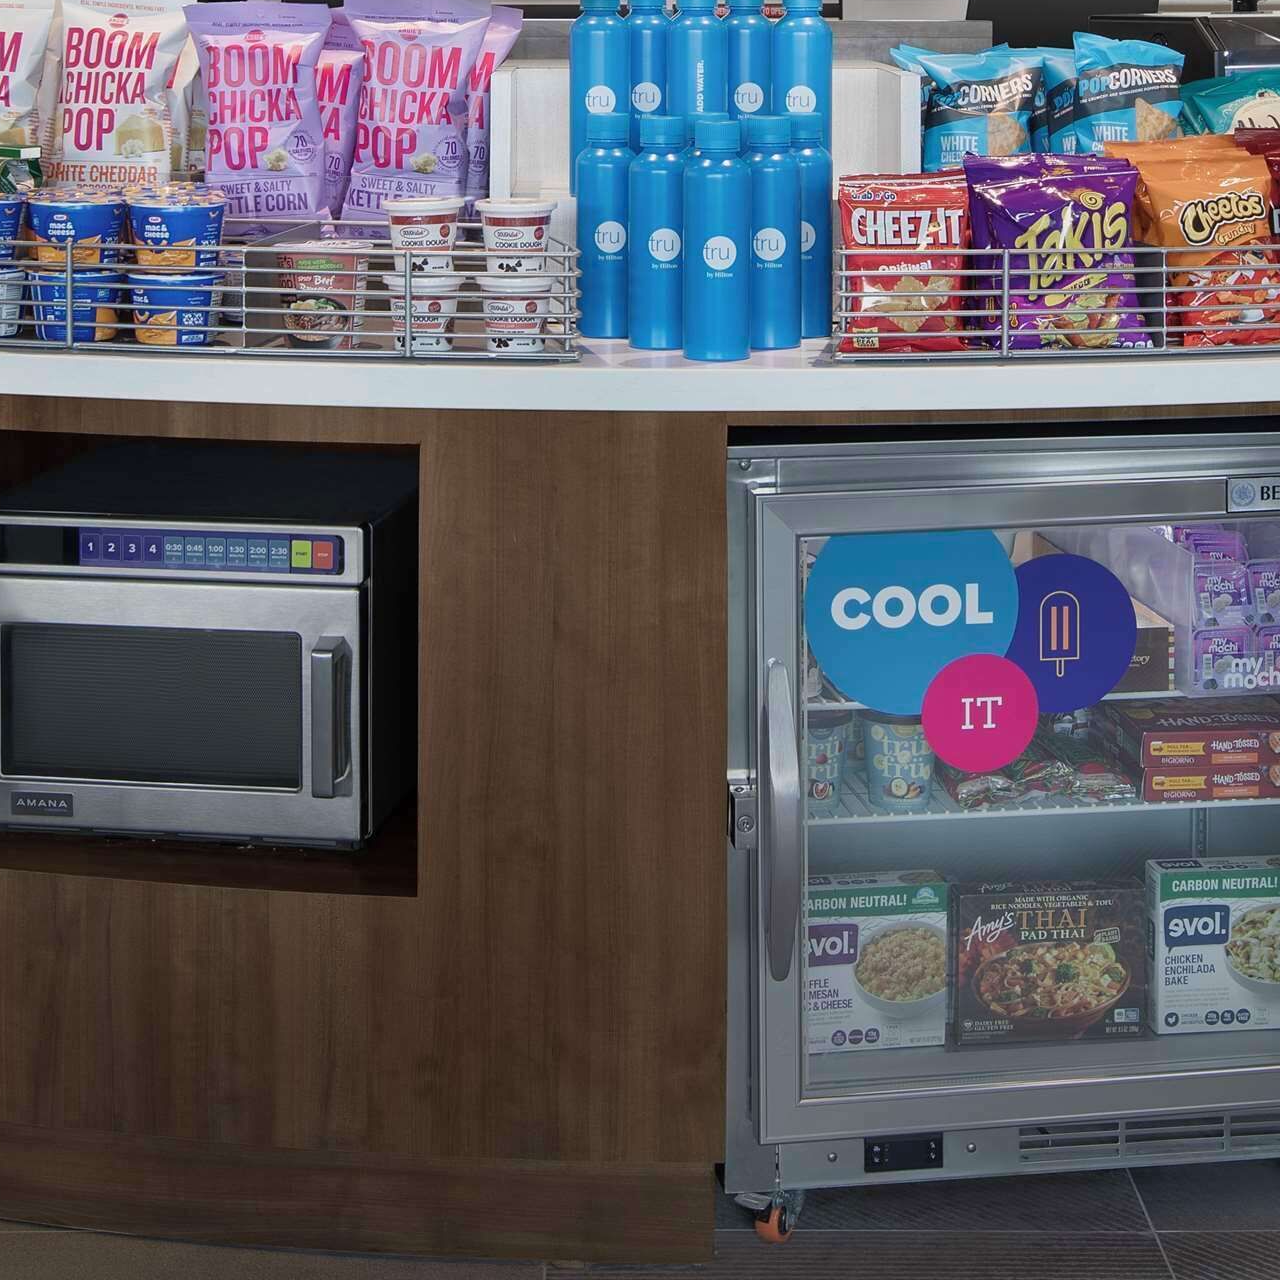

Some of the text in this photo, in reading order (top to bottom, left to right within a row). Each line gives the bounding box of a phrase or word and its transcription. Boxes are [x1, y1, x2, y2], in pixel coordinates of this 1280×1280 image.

[65, 27, 161, 70] BOOM
[207, 43, 303, 88] BOOM
[360, 39, 462, 90] BOOM
[64, 71, 146, 105] CHICKA
[1079, 68, 1177, 97] POPCORNERS
[586, 91, 609, 108] tru
[632, 89, 655, 104] tru
[734, 89, 758, 104] tru
[786, 92, 810, 108] tru
[208, 87, 302, 125] CHICKA
[359, 85, 452, 125] CHICKA
[63, 107, 115, 151] POP
[1092, 127, 1129, 142] WHITE
[208, 127, 269, 171] POP
[355, 122, 417, 169] POP
[445, 141, 457, 155] 70
[941, 135, 979, 151] WHITE
[473, 145, 485, 160] 70
[328, 155, 340, 169] 70
[89, 164, 158, 183] CHEDDAR
[221, 180, 291, 194] SWEET & SALTY
[361, 177, 436, 195] SWEET & SALTY
[265, 192, 308, 212] CORN
[883, 192, 896, 201] Go
[1181, 192, 1266, 245] Cheetos
[595, 228, 620, 244] tru
[1216, 222, 1257, 246] Crunchy
[425, 239, 449, 247] DOUGH
[495, 241, 543, 249] COOKIE DOUGH
[649, 235, 674, 252] tru
[754, 235, 779, 252] tru
[704, 243, 730, 260] tru
[765, 261, 782, 269] Hilton
[715, 270, 733, 278] Hilton
[87, 542, 94, 552] 1
[108, 542, 116, 553] 2
[128, 543, 137, 553] 3
[149, 544, 157, 554] 4
[165, 543, 182, 552] 0:30
[186, 544, 203, 552] 0:45
[208, 545, 224, 554] 1:00
[229, 545, 245, 554] 1:30
[249, 546, 266, 555] 2:00
[271, 547, 288, 556] 2:30
[831, 583, 993, 631] COOL
[1232, 657, 1263, 675] my
[961, 696, 1003, 730] IT
[1211, 738, 1259, 752] HAND-TOSSED
[1212, 771, 1261, 785] HAND-TOSSED
[16, 797, 69, 809] AMANA
[1172, 876, 1279, 892] CARBON NEUTRAL!
[808, 894, 907, 910] ARBON NEUTRAL!
[1017, 908, 1089, 930] THAI
[1169, 911, 1226, 938] evol.
[964, 911, 1017, 951] Amy's
[1021, 928, 1086, 941] PAD THAI
[1164, 953, 1204, 966] CHICKEN
[1164, 964, 1216, 976] ENCHILADA
[809, 978, 829, 990] FFLE
[1164, 975, 1189, 987] BAKE
[809, 989, 839, 1000] MESAN
[813, 999, 853, 1011] & CHEESE
